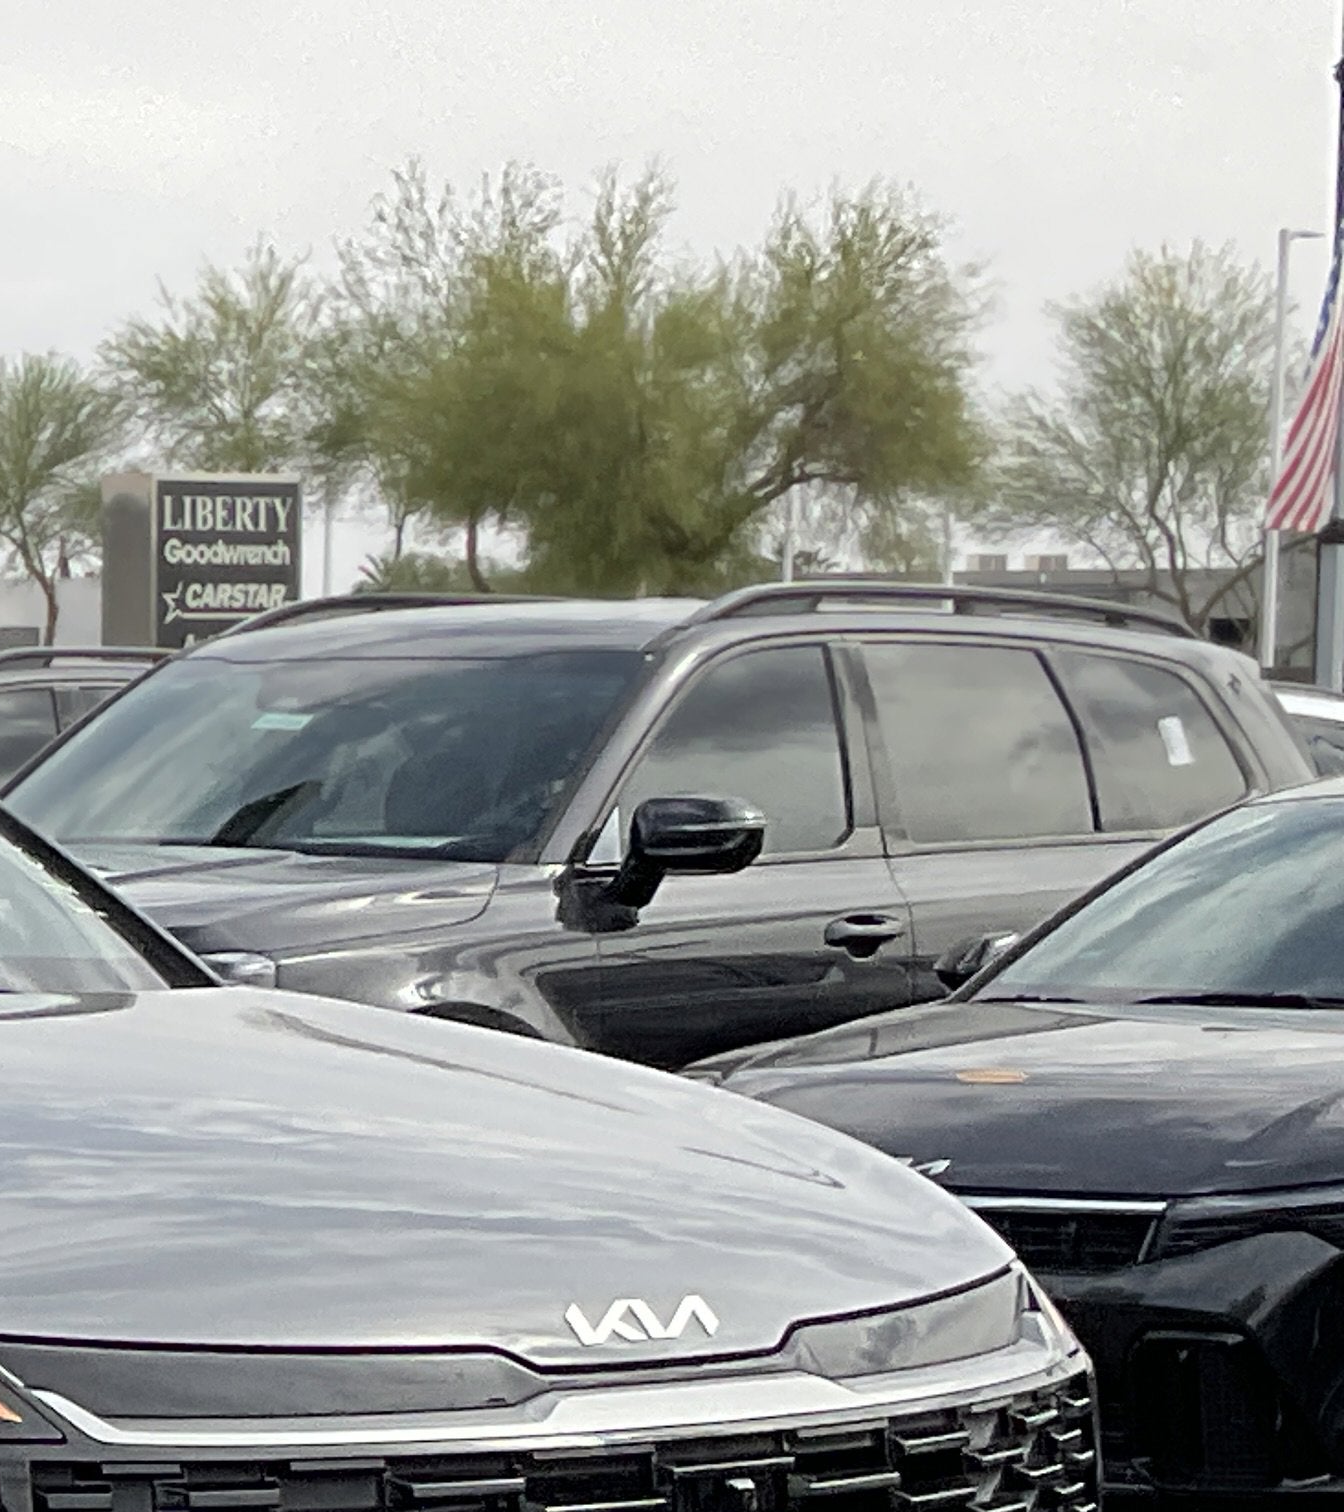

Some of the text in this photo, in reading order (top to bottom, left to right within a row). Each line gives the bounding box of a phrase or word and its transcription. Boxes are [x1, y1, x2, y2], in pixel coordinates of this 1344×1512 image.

[162, 495, 293, 532] LIBERTY
[164, 537, 291, 565] Goodwrench
[184, 583, 287, 608] CARSTAR
[564, 1294, 720, 1347] KIA
